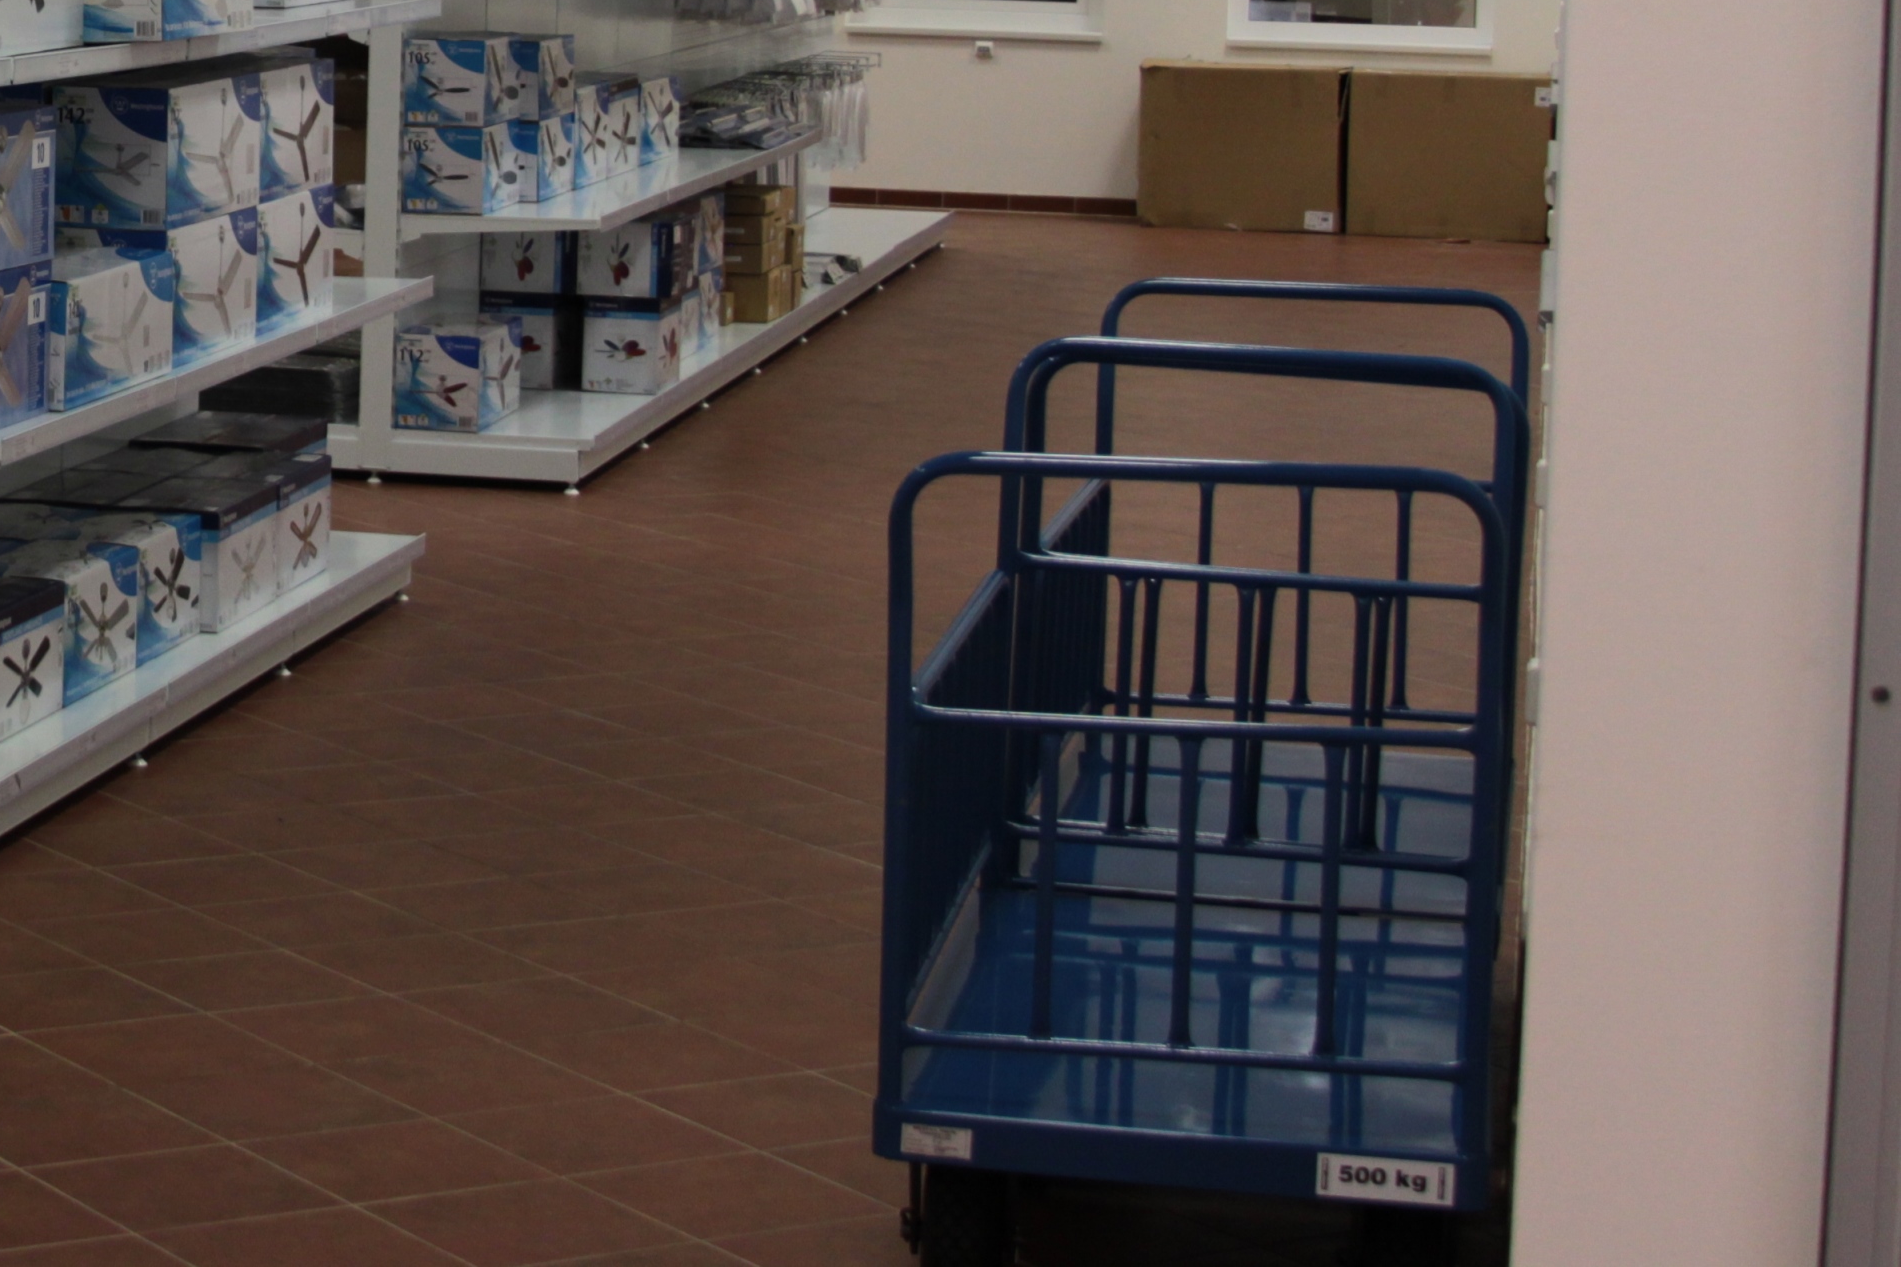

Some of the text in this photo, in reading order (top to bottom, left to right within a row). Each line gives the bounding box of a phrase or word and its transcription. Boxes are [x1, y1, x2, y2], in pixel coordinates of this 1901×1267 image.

[408, 50, 430, 64] 105
[58, 107, 85, 124] 142
[38, 142, 45, 165] 10
[408, 137, 430, 151] 105
[33, 298, 41, 319] 10
[1339, 1165, 1428, 1193] 500 kg
